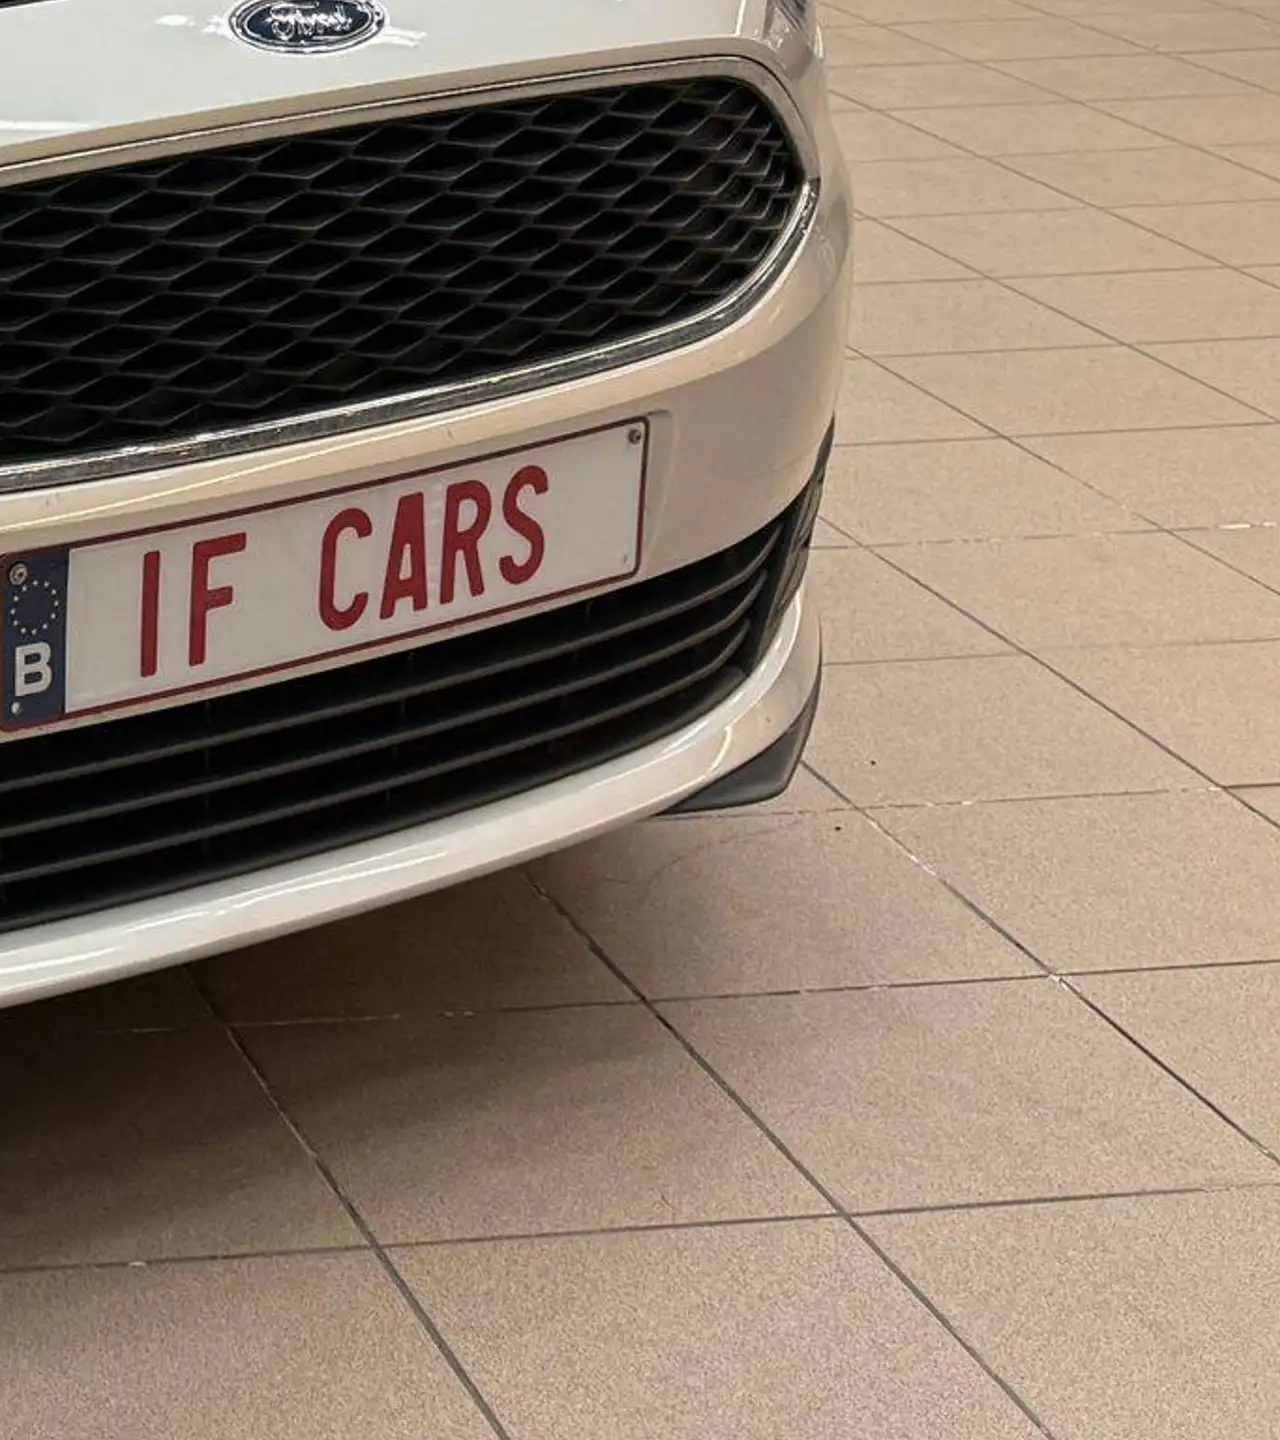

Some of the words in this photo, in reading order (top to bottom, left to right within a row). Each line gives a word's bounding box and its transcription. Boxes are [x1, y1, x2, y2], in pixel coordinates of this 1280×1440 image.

[140, 531, 247, 678] IF
[318, 464, 549, 631] CARS
[15, 641, 52, 697] B
